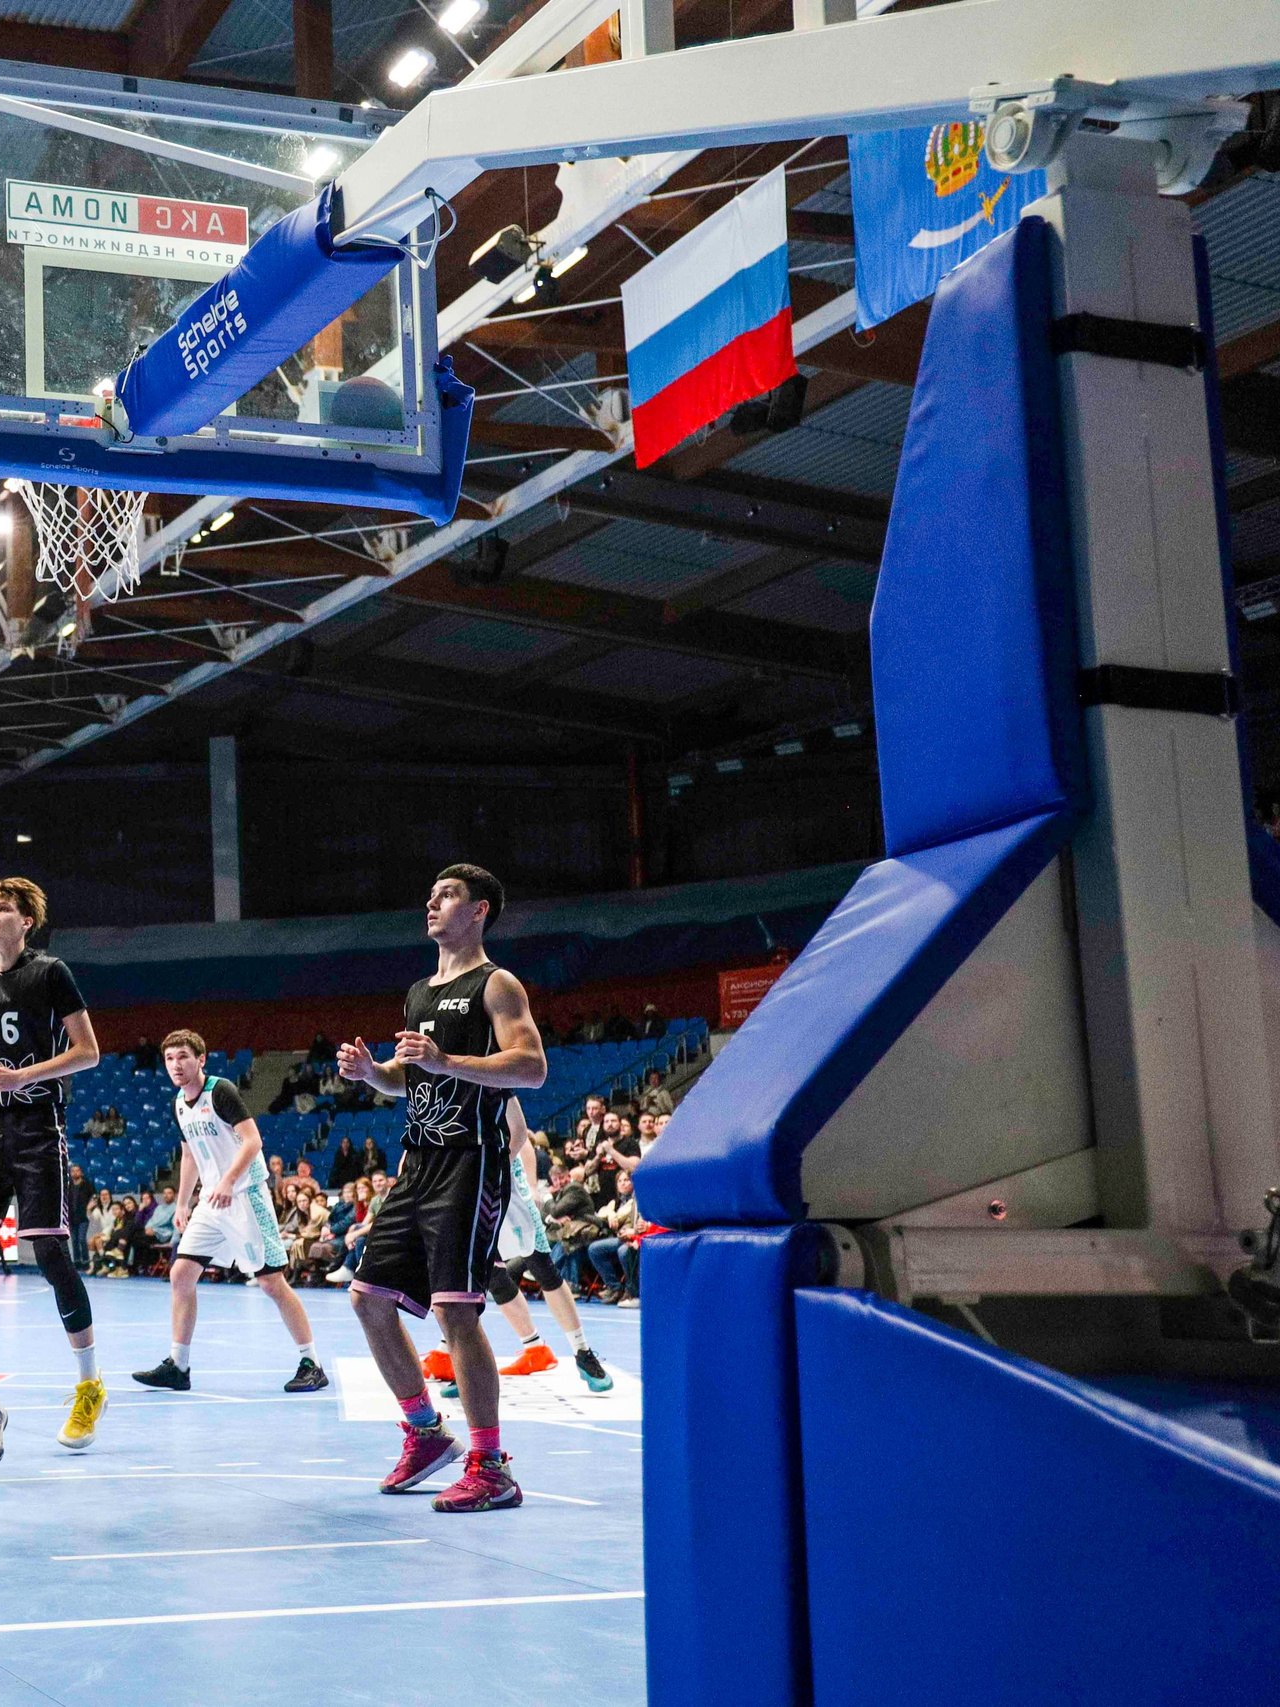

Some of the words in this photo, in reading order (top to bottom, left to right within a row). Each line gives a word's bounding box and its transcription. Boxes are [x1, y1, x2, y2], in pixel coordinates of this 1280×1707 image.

[178, 289, 239, 358] Schelde
[184, 312, 247, 380] Sports
[72, 464, 99, 475] Sports
